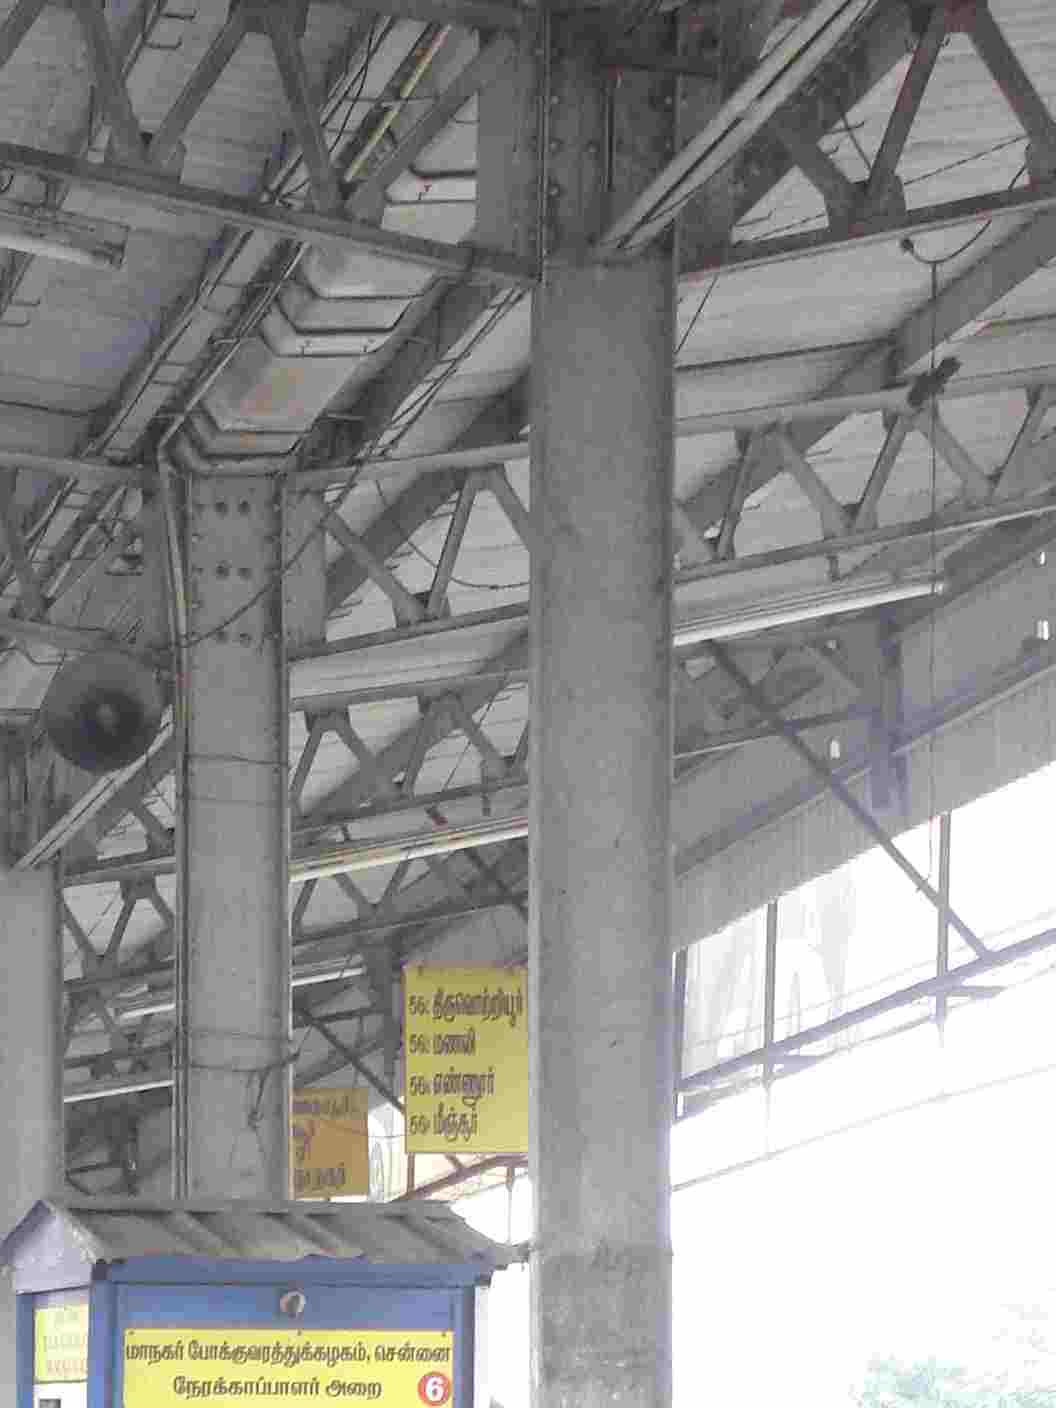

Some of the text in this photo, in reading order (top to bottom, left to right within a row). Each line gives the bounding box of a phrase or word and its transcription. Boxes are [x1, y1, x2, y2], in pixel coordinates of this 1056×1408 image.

[125, 1340, 184, 1366] மாநகர்
[374, 1340, 451, 1362] சென்னை
[173, 1376, 382, 1400] நேரக்காப்பாளர் அறை
[425, 1376, 444, 1402] 6
